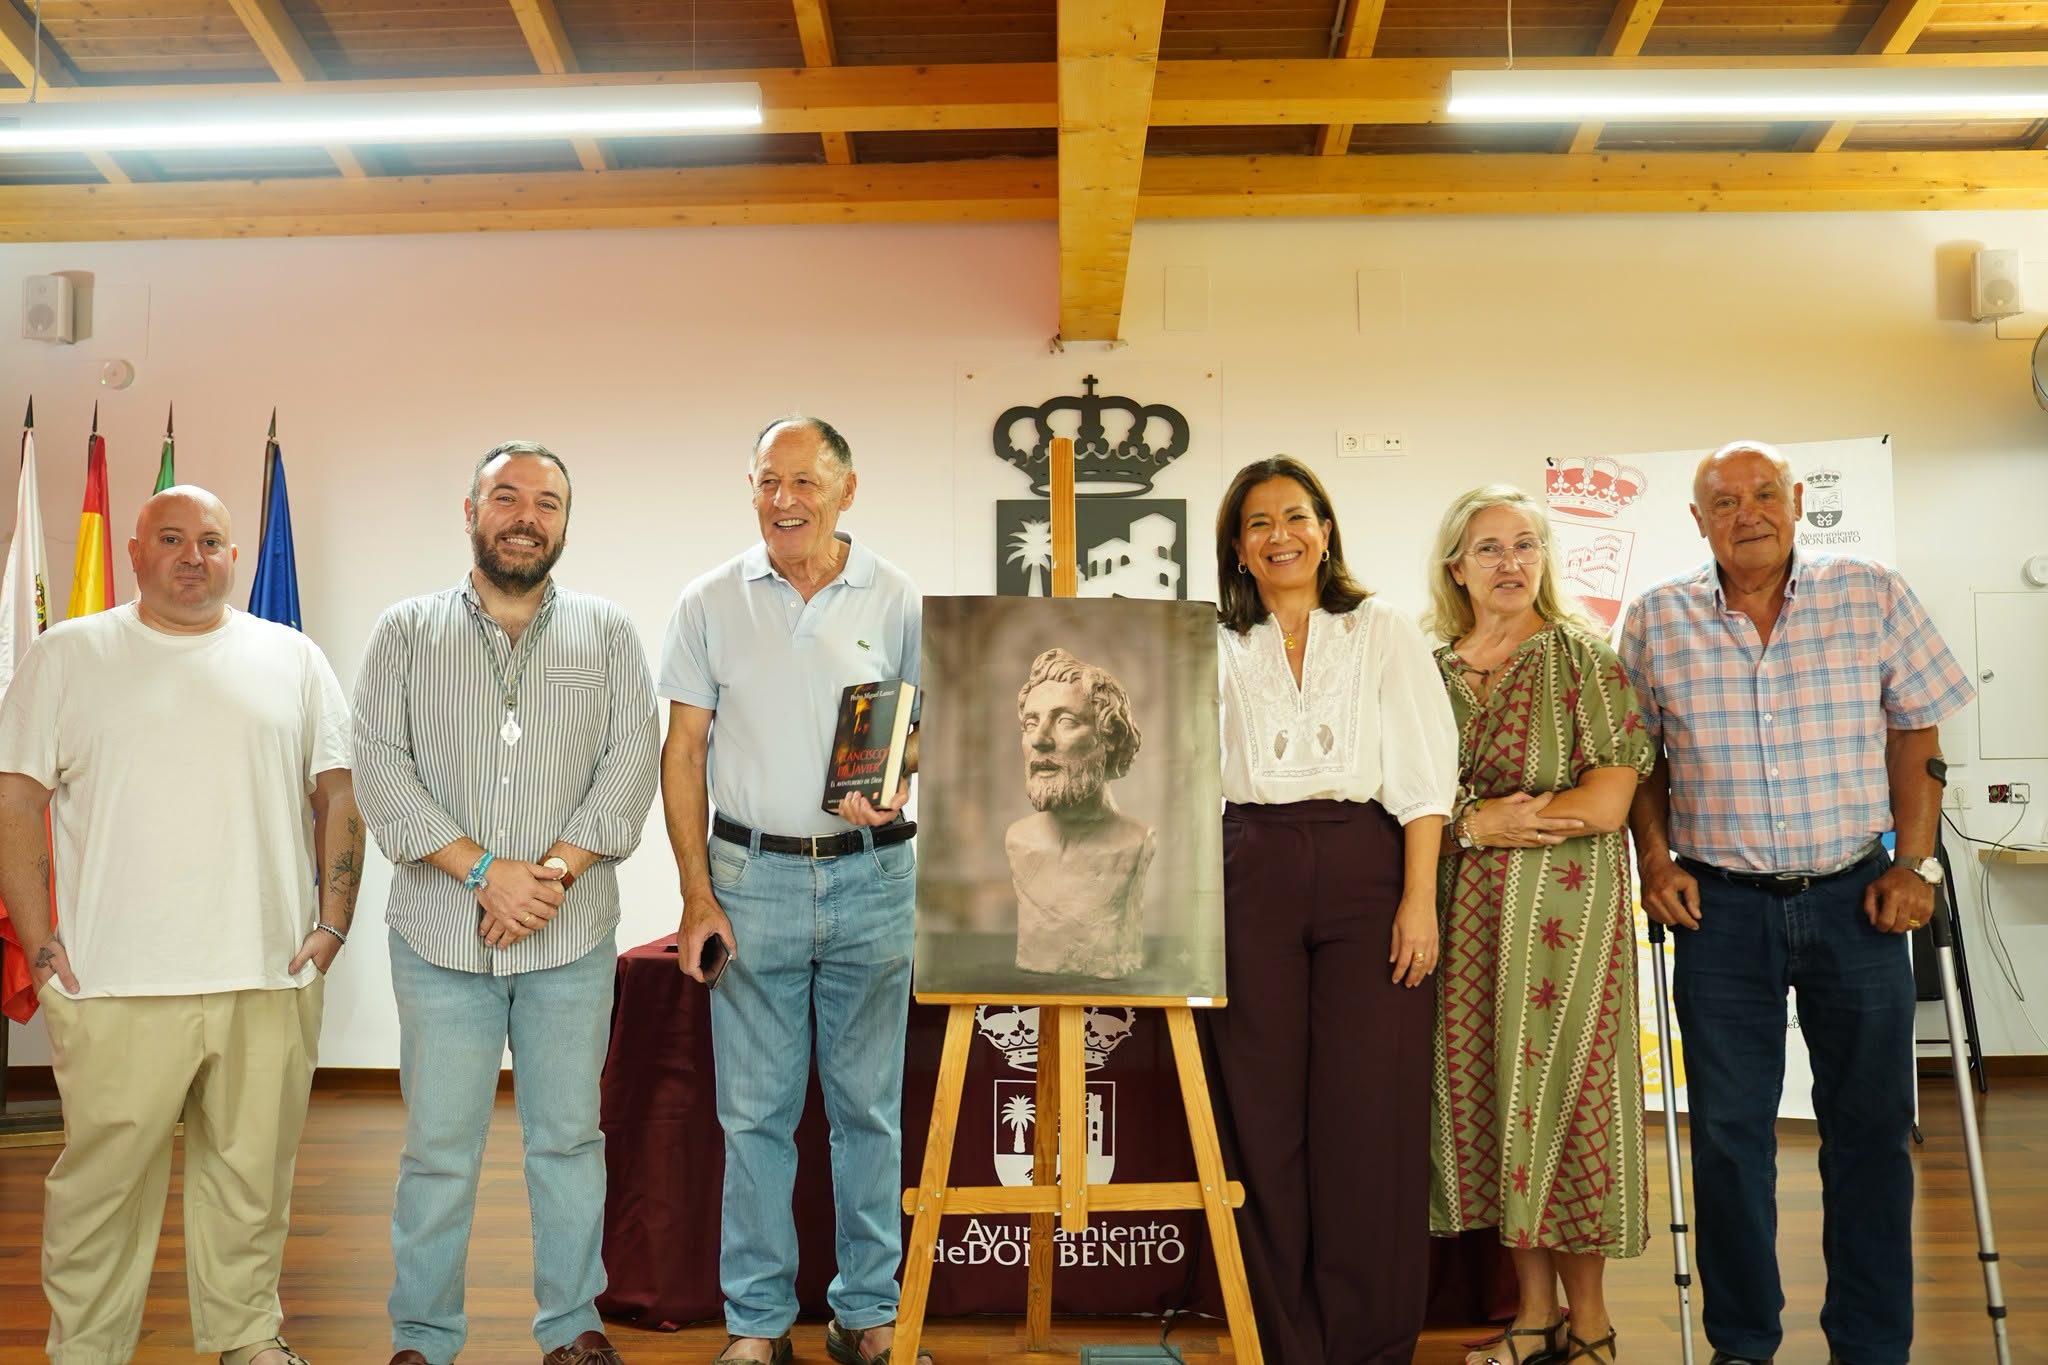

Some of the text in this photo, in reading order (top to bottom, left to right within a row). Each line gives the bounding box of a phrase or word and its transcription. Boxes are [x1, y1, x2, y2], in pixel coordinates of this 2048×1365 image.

[1800, 530, 1859, 540] Ayuntamiento
[1826, 535, 1861, 544] BENITO
[1059, 1239, 1185, 1267] BENITO
